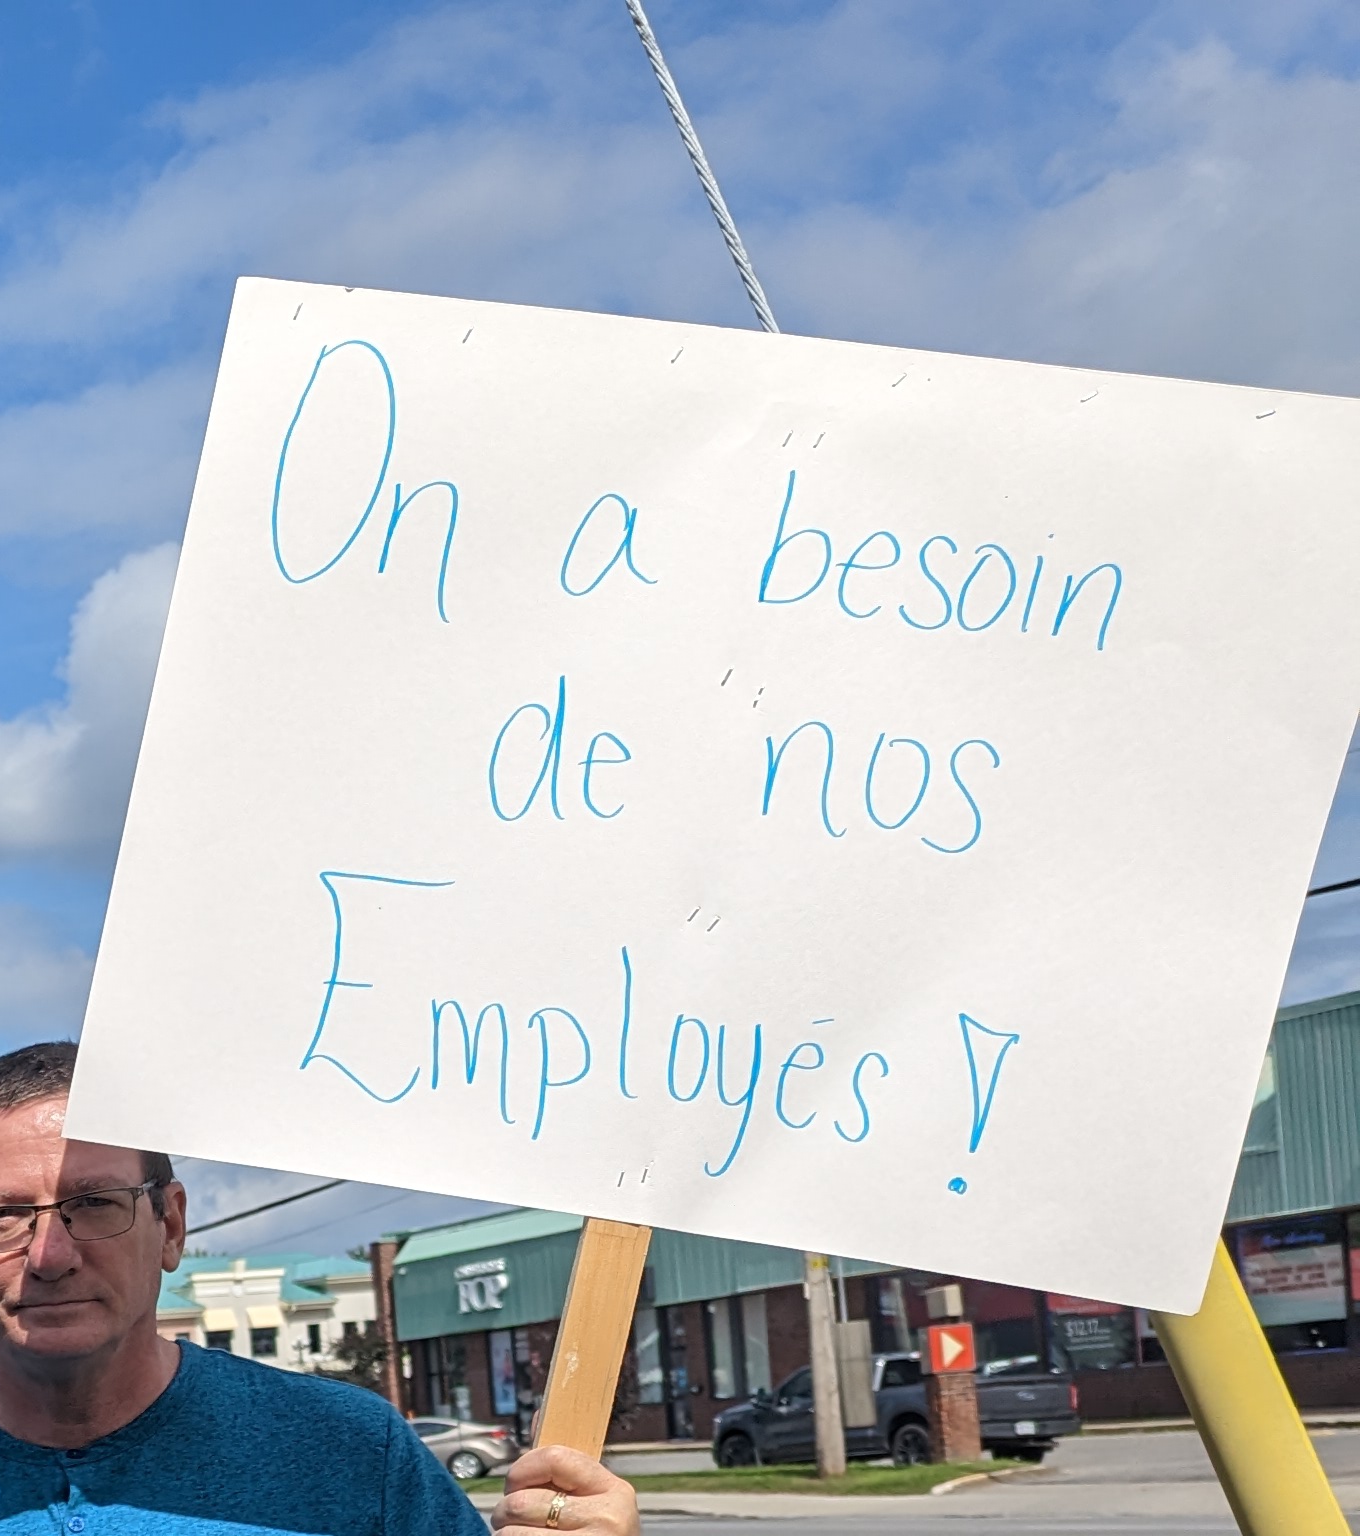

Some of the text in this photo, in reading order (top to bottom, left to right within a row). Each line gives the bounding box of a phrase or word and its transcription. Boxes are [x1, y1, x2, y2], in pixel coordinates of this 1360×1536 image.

[272, 340, 1122, 650] On a besoin
[489, 675, 1001, 853] de nos
